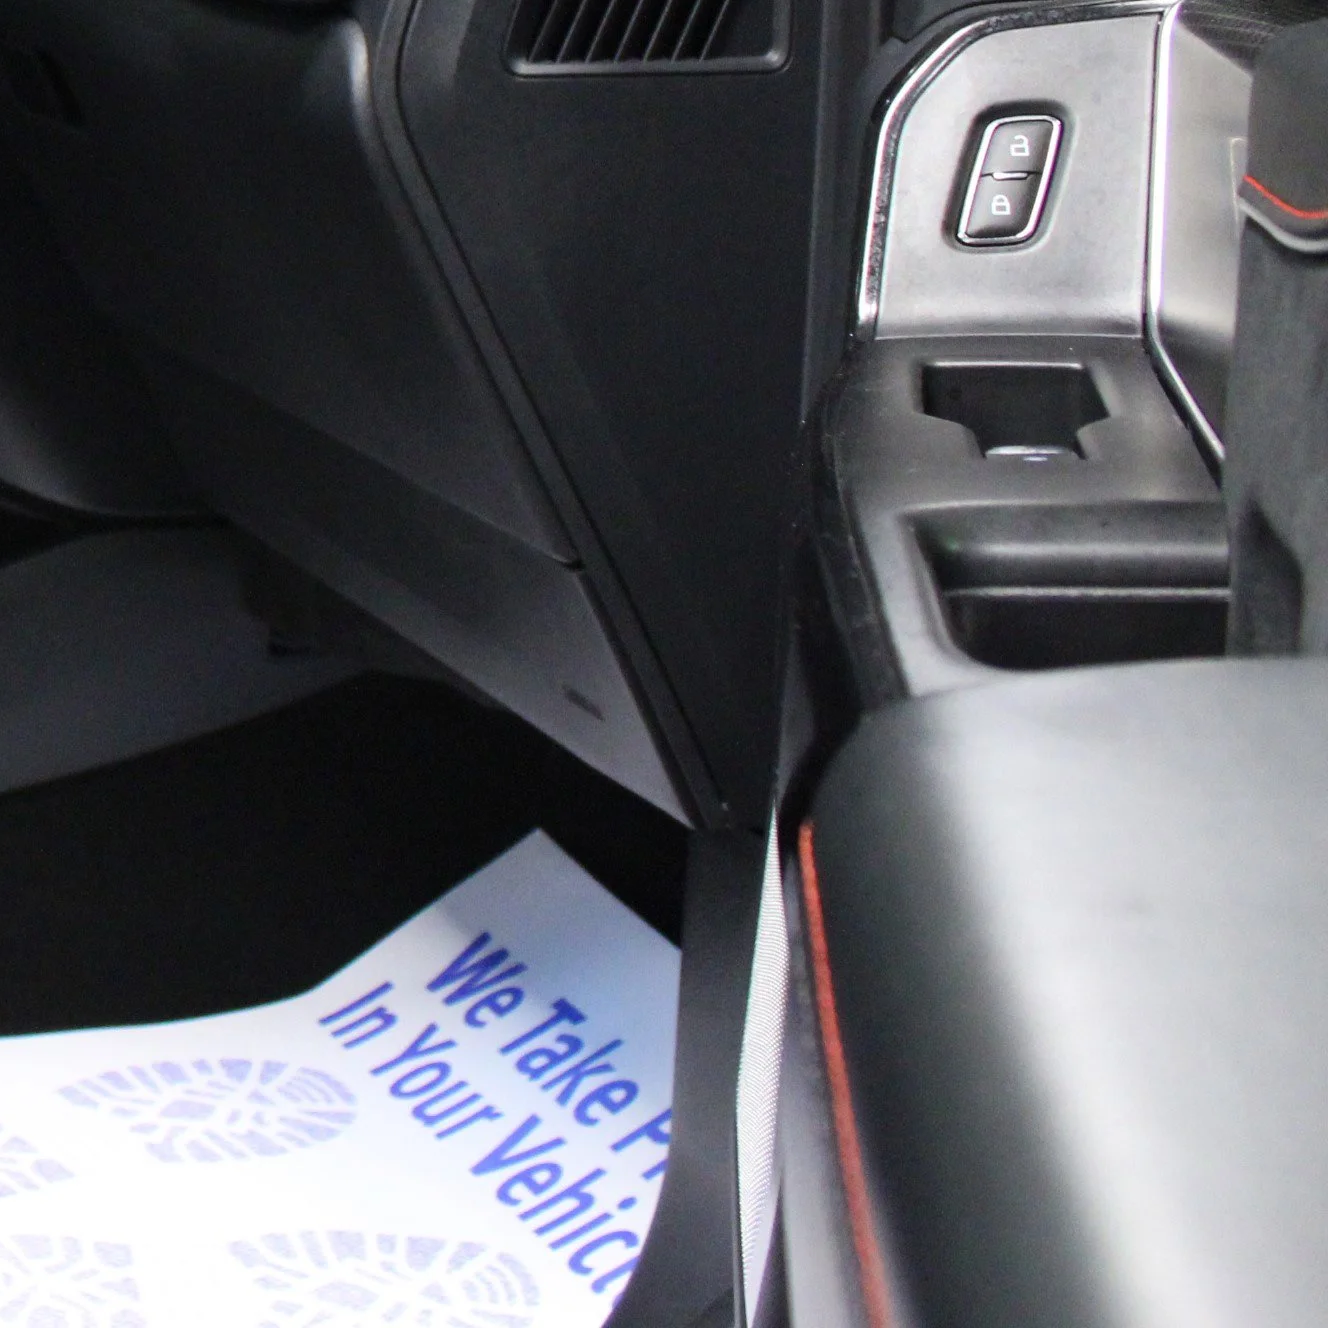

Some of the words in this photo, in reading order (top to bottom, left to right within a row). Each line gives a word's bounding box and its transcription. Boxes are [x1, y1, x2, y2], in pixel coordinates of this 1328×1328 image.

[318, 981, 399, 1049] In
[370, 1022, 503, 1140] Your
[470, 1114, 642, 1310] Vehicl
[425, 931, 528, 1029] We
[498, 997, 640, 1127] Take
